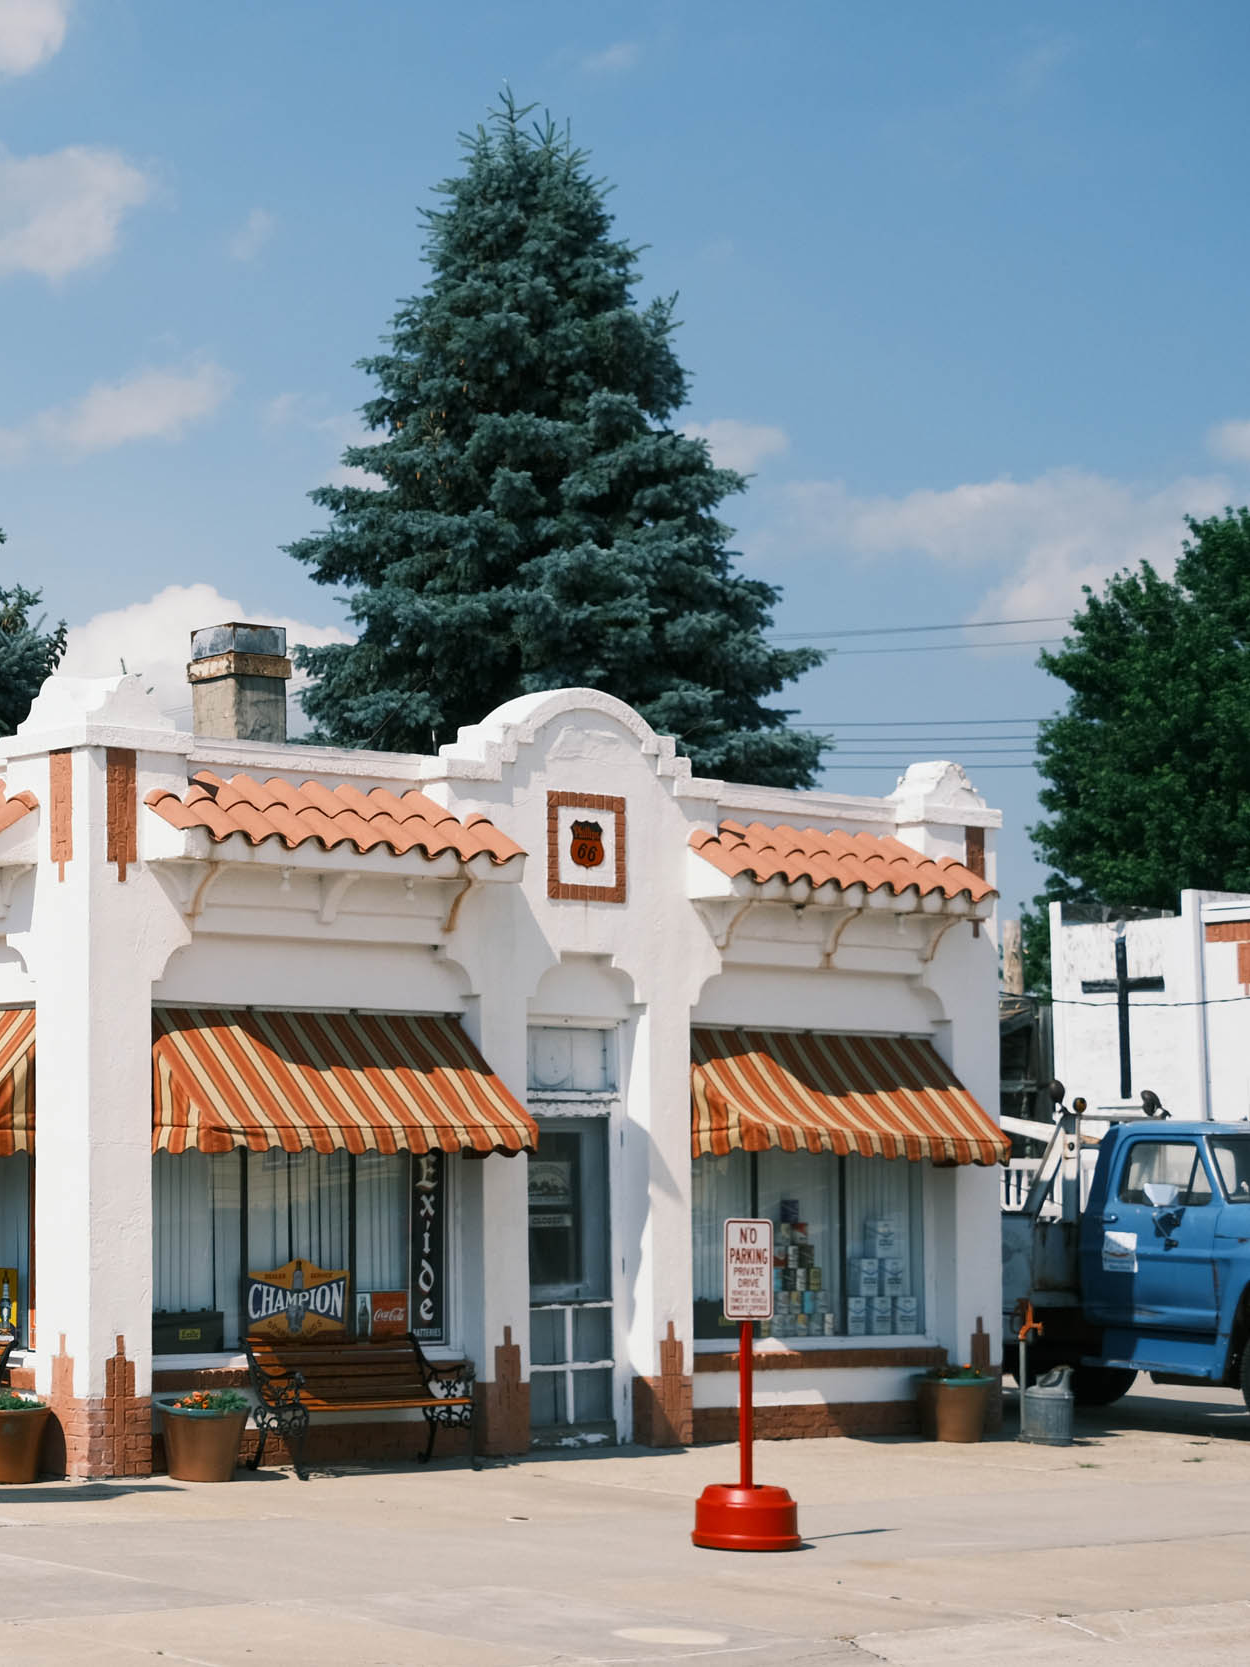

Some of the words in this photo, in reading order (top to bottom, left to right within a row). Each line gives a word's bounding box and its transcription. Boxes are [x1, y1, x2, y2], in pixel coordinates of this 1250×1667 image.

[577, 843, 598, 862] 66
[415, 1154, 439, 1321] Exide
[740, 1227, 758, 1244] NO
[730, 1248, 768, 1265] PARKING
[733, 1266, 764, 1277] PRIVATE
[738, 1278, 760, 1288] DRIVE
[248, 1281, 345, 1319] CHAMPION
